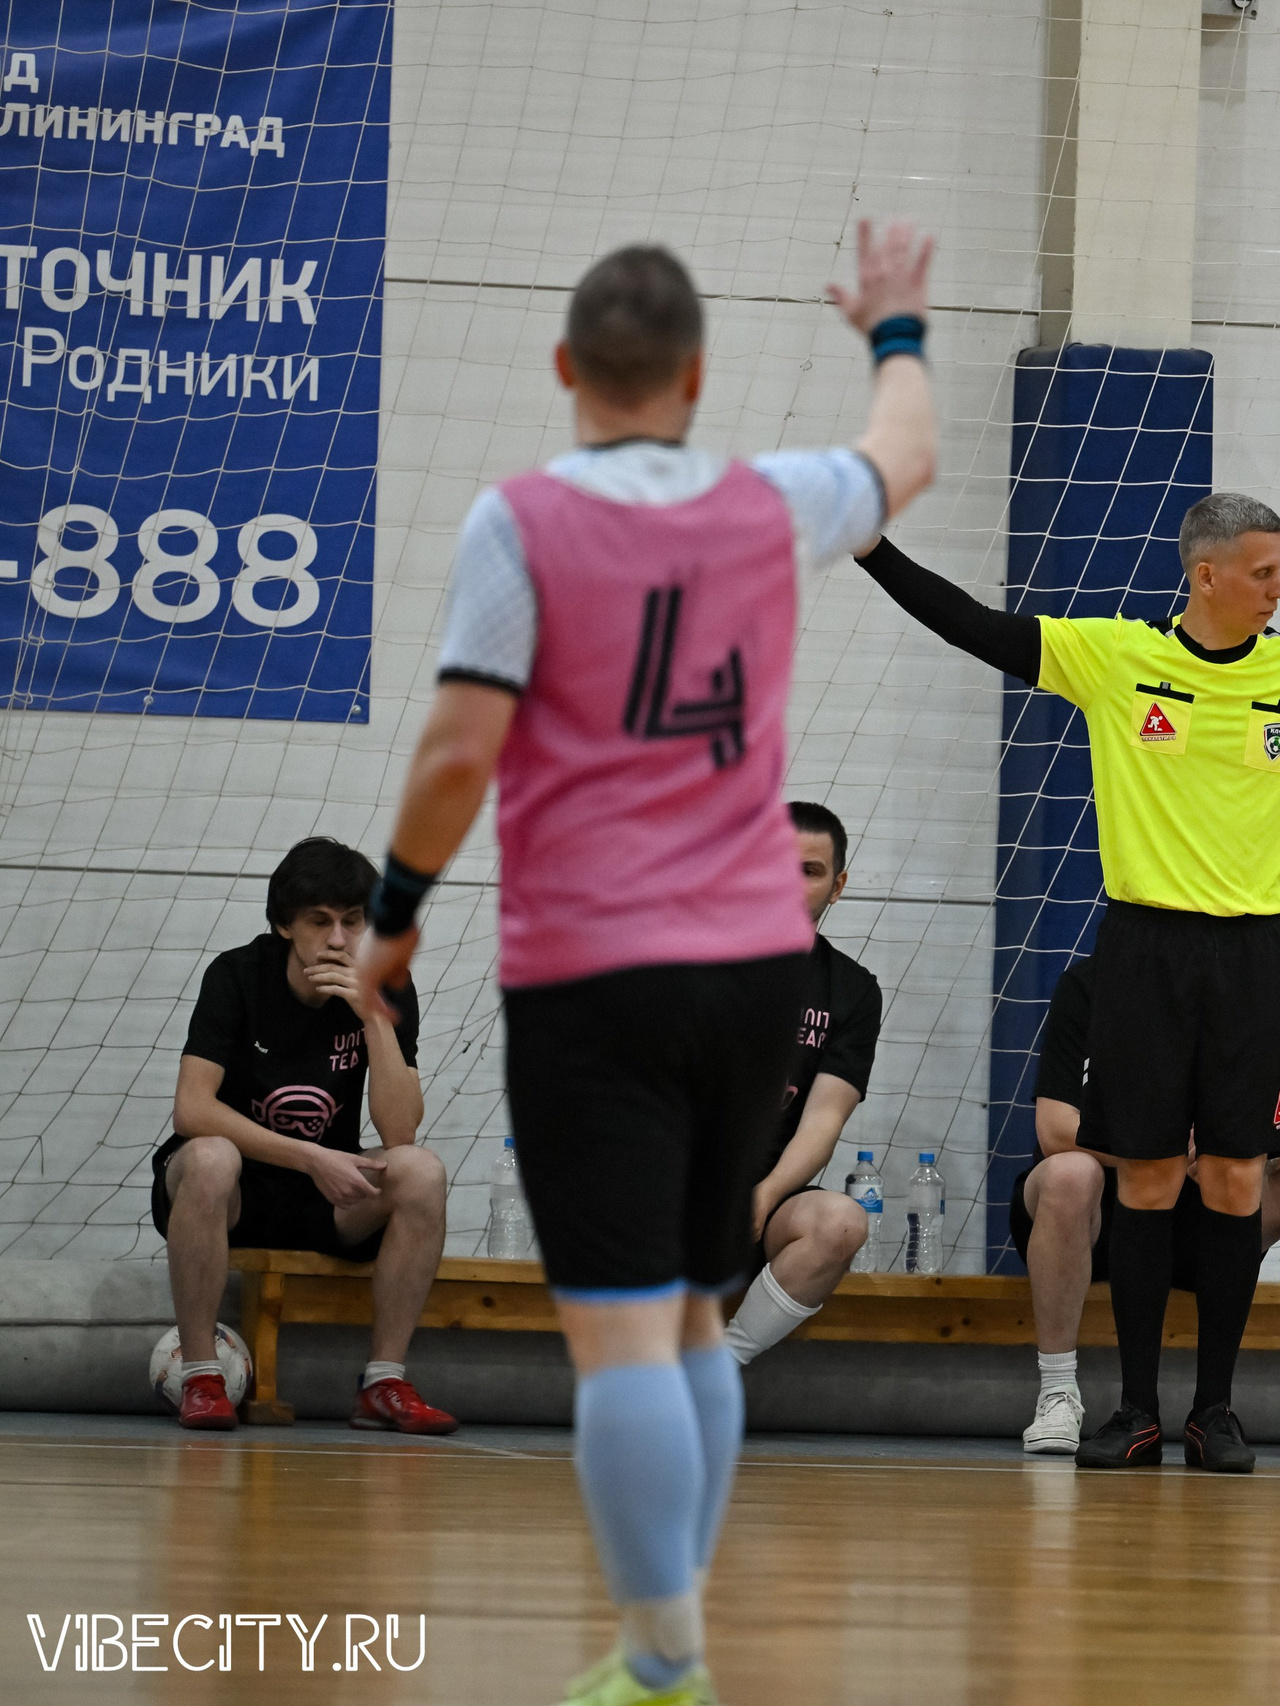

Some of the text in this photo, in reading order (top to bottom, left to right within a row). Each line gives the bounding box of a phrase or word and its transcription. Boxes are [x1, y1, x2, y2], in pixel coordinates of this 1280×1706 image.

[4, 53, 39, 93] Д
[0, 103, 285, 158] ЛИНИНГРАД
[0, 244, 318, 324] ТОЧНИК
[22, 327, 319, 403] Родники
[623, 586, 744, 770] 4
